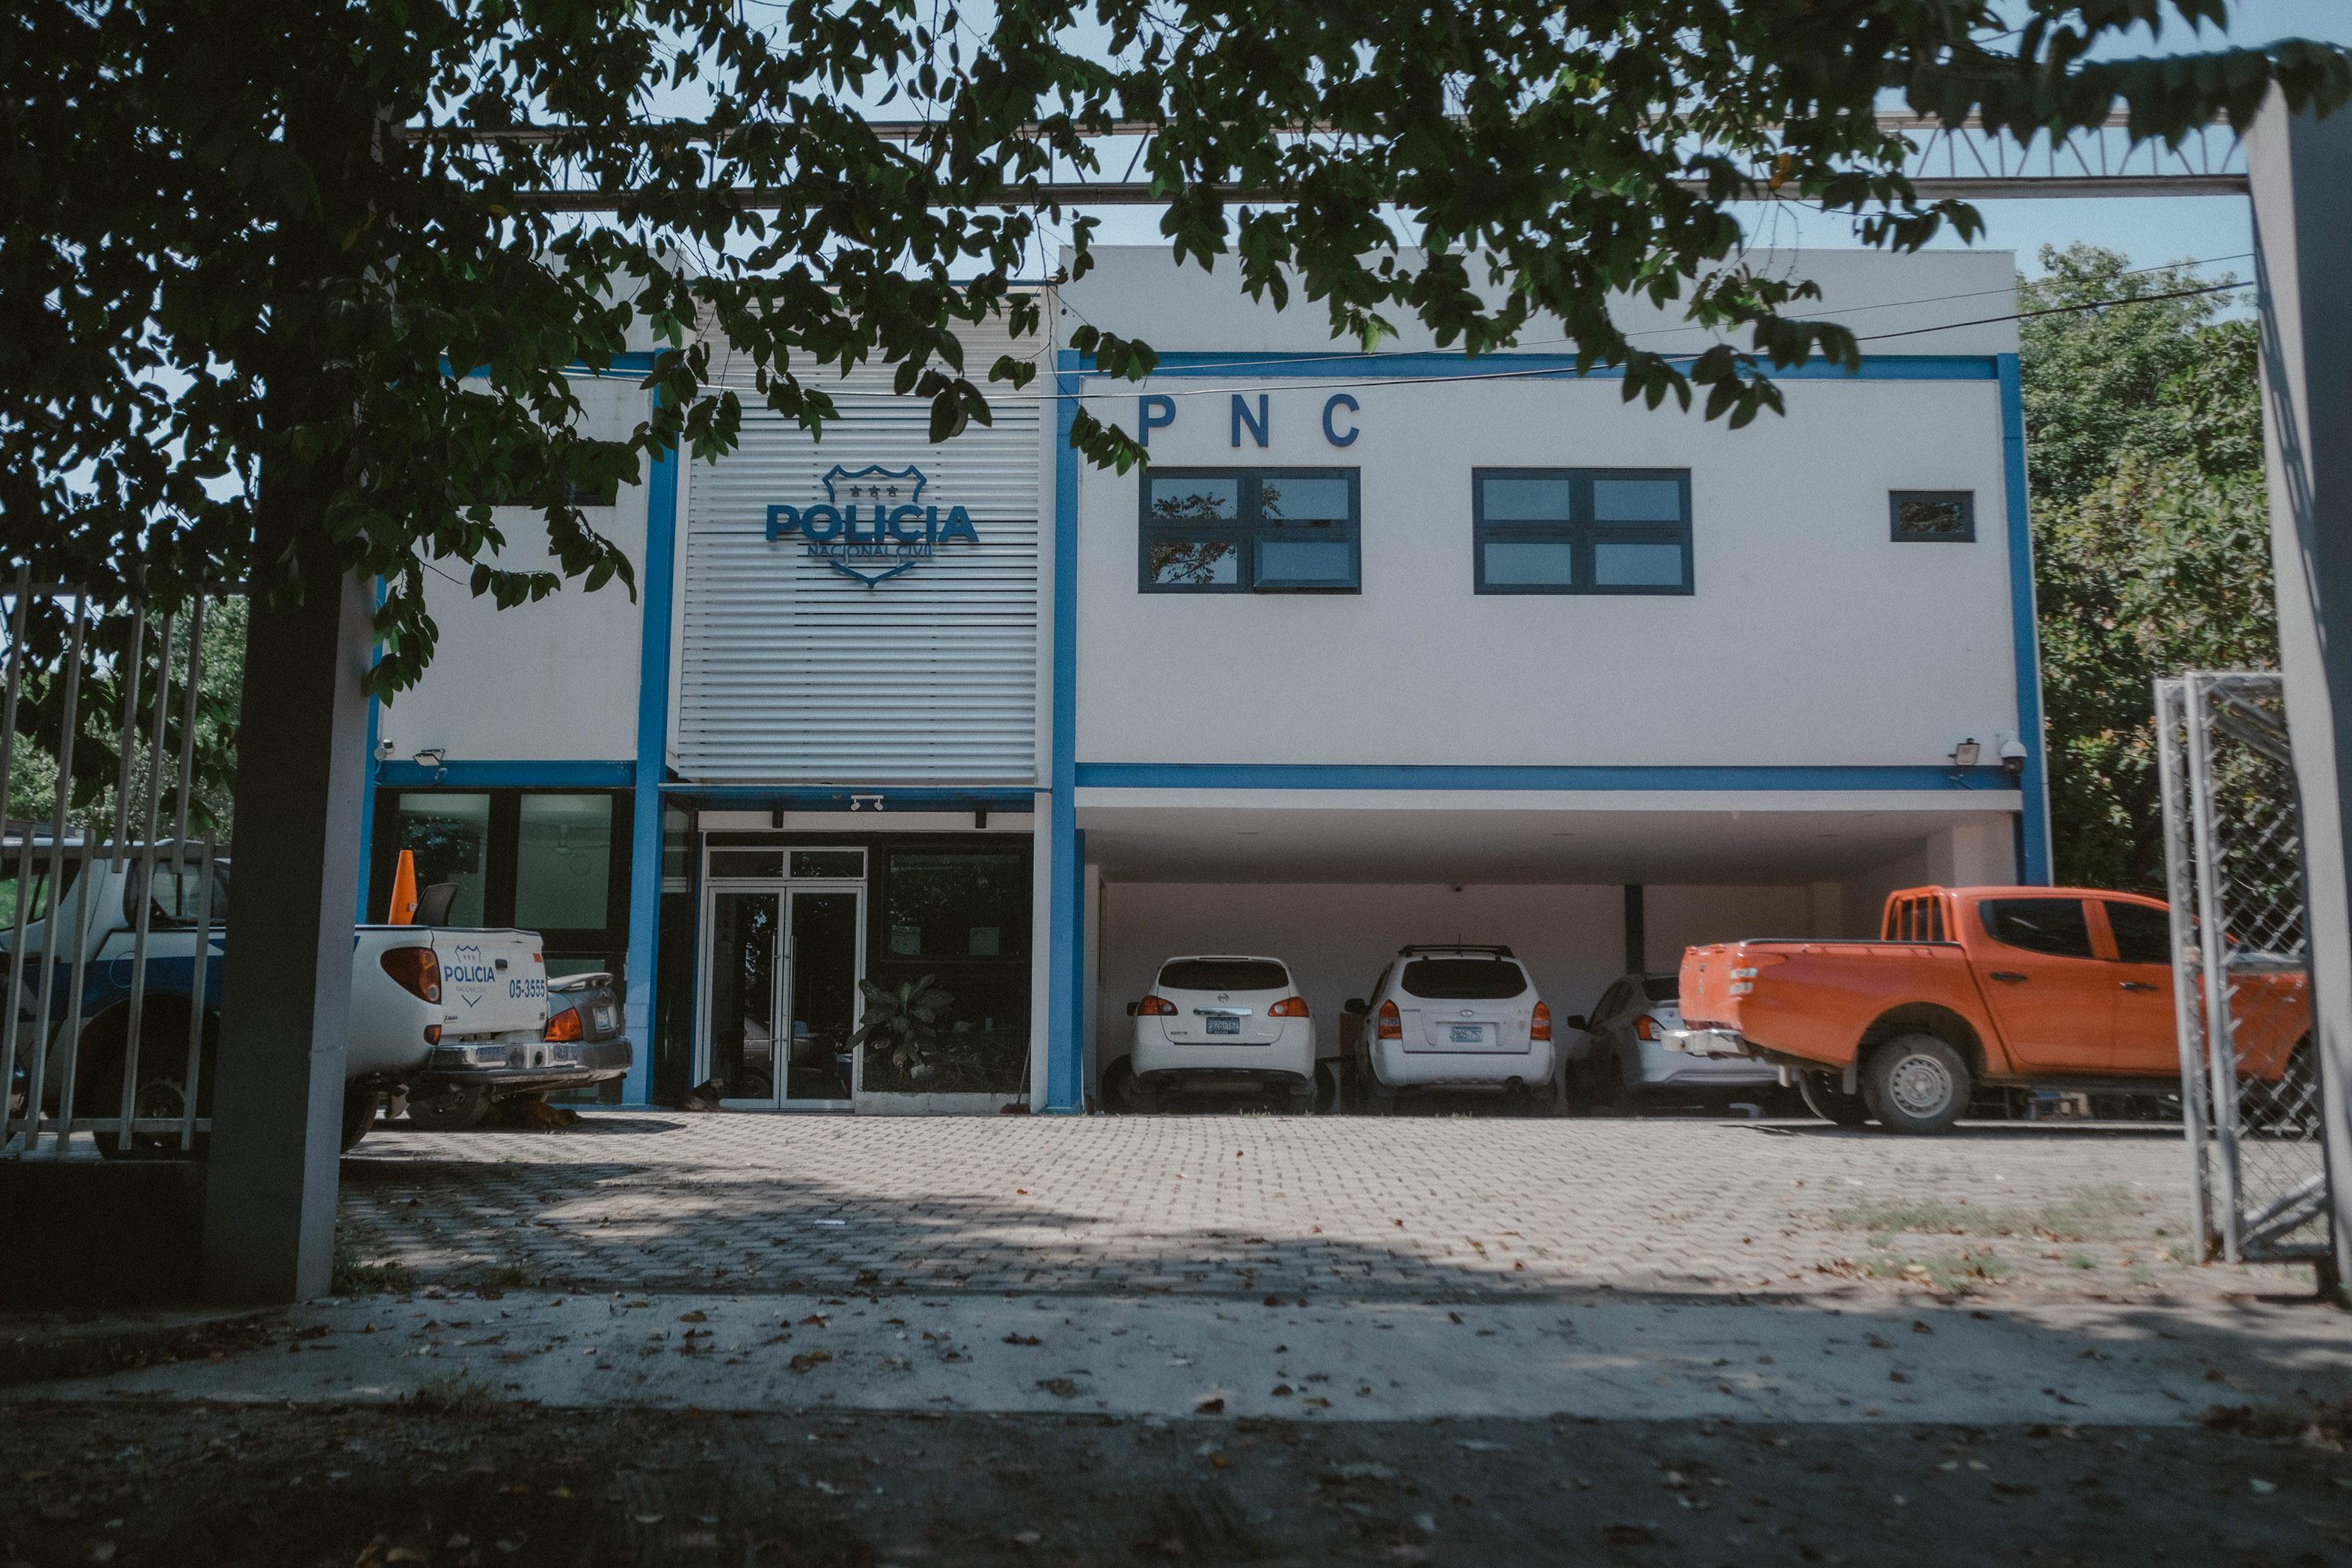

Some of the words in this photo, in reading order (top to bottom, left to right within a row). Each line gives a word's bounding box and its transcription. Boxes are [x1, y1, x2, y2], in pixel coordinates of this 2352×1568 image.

[765, 503, 979, 543] POLICIA
[807, 544, 892, 557] NACIONAL
[896, 544, 935, 557] CIVIL
[444, 965, 495, 983] POLICIA
[509, 978, 545, 999] 05-3555
